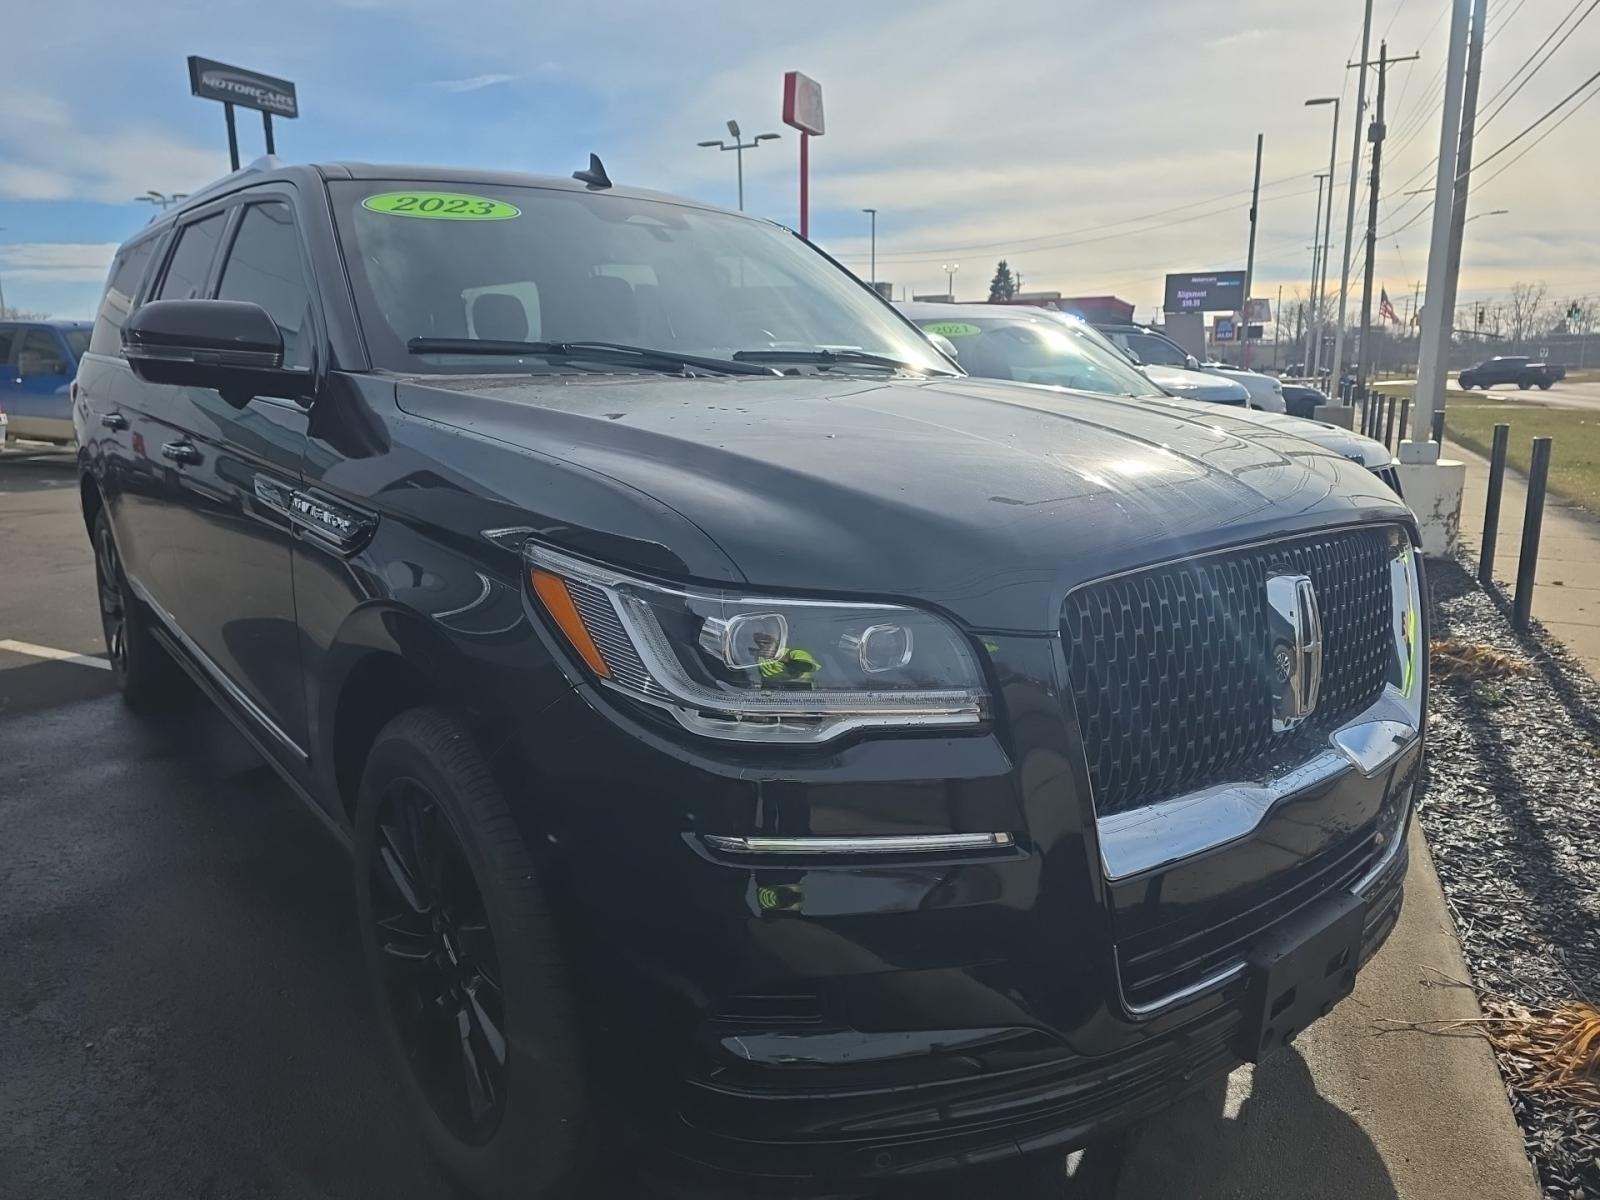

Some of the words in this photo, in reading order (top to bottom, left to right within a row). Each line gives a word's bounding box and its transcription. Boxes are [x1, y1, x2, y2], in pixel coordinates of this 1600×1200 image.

[202, 76, 295, 105] MOTORCARS
[391, 197, 496, 215] 2023
[1177, 289, 1207, 299] Alignment
